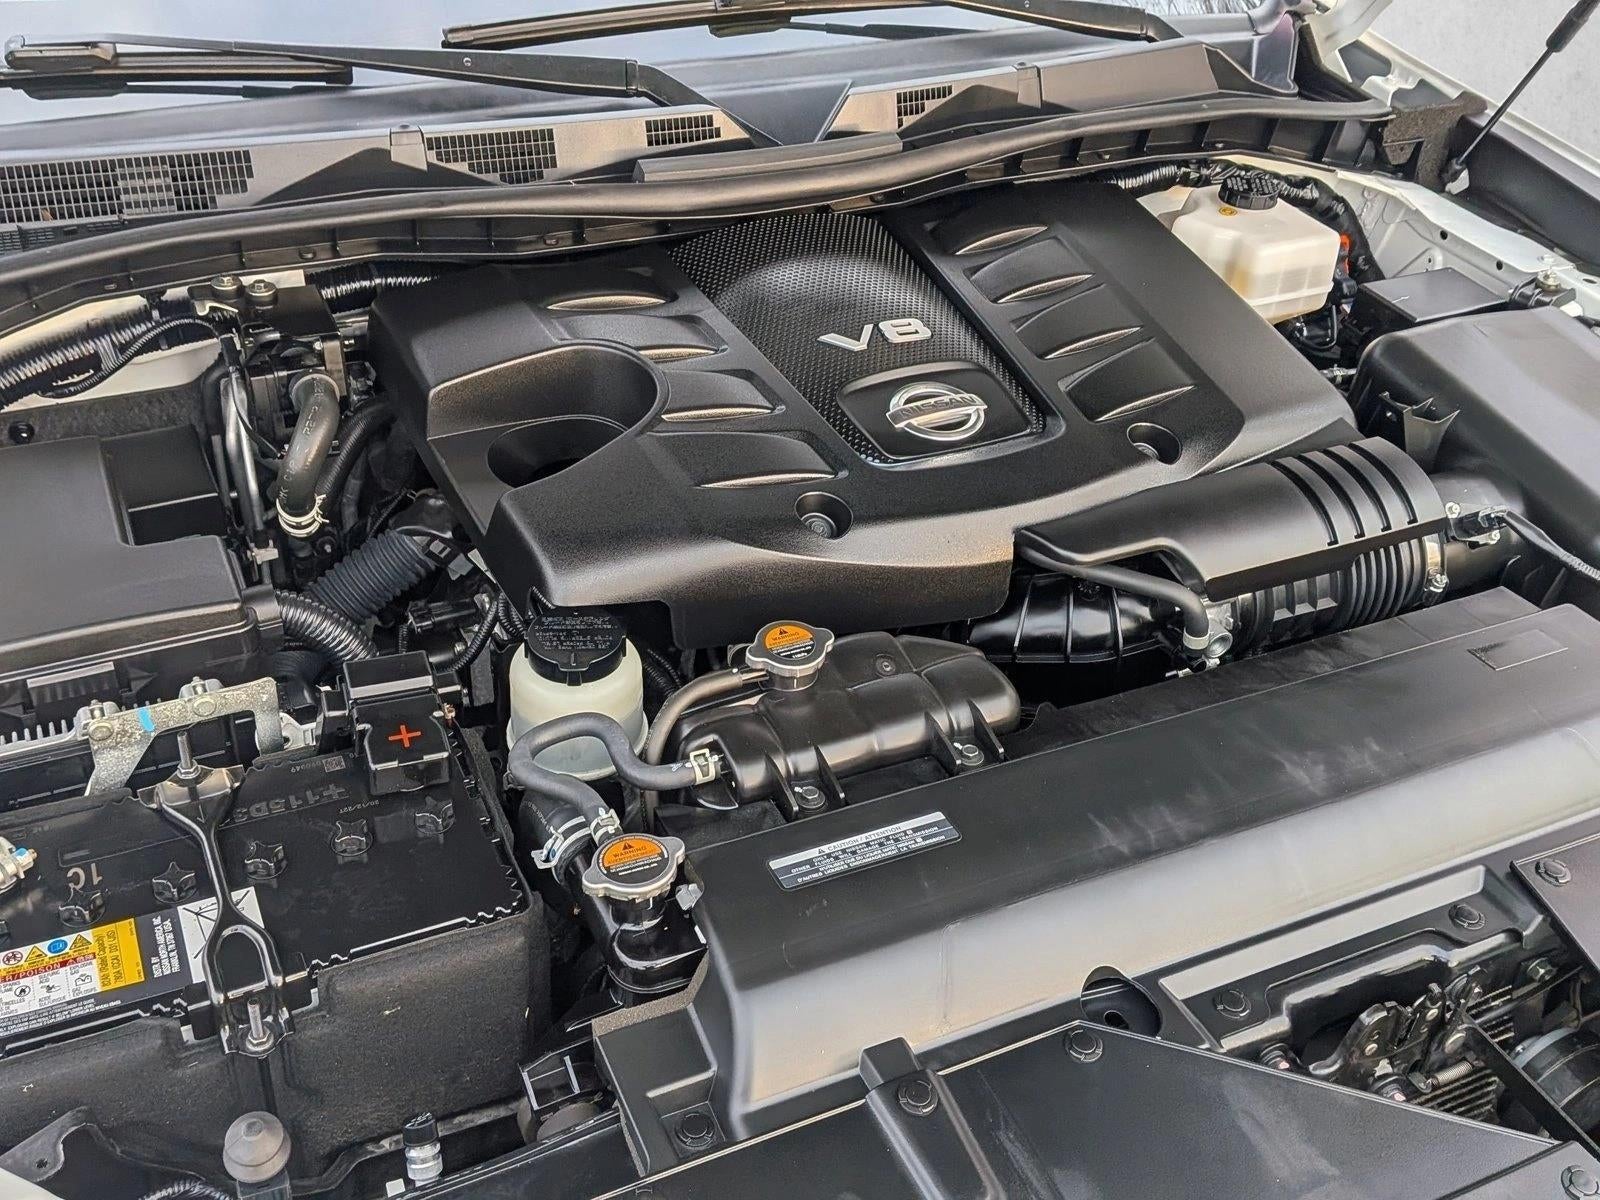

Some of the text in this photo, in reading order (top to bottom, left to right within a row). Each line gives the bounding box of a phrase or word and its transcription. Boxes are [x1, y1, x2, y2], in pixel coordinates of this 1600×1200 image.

[817, 318, 932, 352] V8
[898, 394, 979, 418] NISSAN
[827, 838, 859, 851] CAUTION
[864, 826, 901, 840] ATTENTION
[612, 846, 647, 858] WARNING
[790, 864, 811, 873] OTHER
[814, 857, 835, 866] FLUIDS
